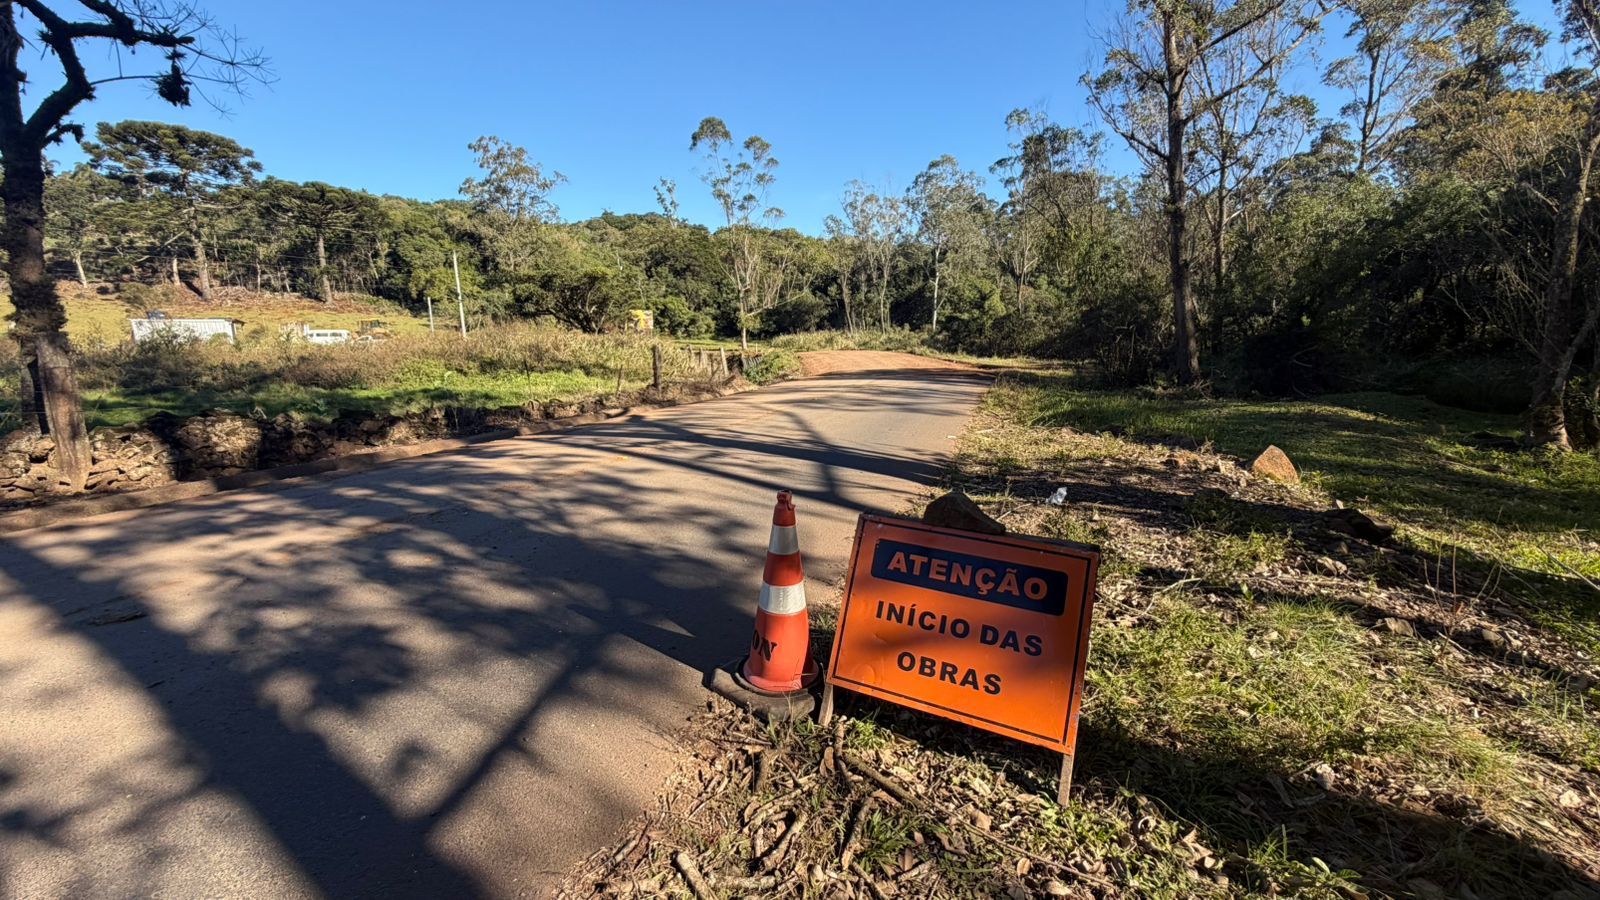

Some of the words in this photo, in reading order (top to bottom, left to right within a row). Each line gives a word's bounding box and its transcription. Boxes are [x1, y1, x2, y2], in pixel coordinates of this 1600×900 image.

[887, 551, 1048, 600] ATENÇÃO
[876, 600, 970, 639] INÍCIO
[979, 624, 1042, 657] DAS
[897, 651, 1002, 695] OBRAS
